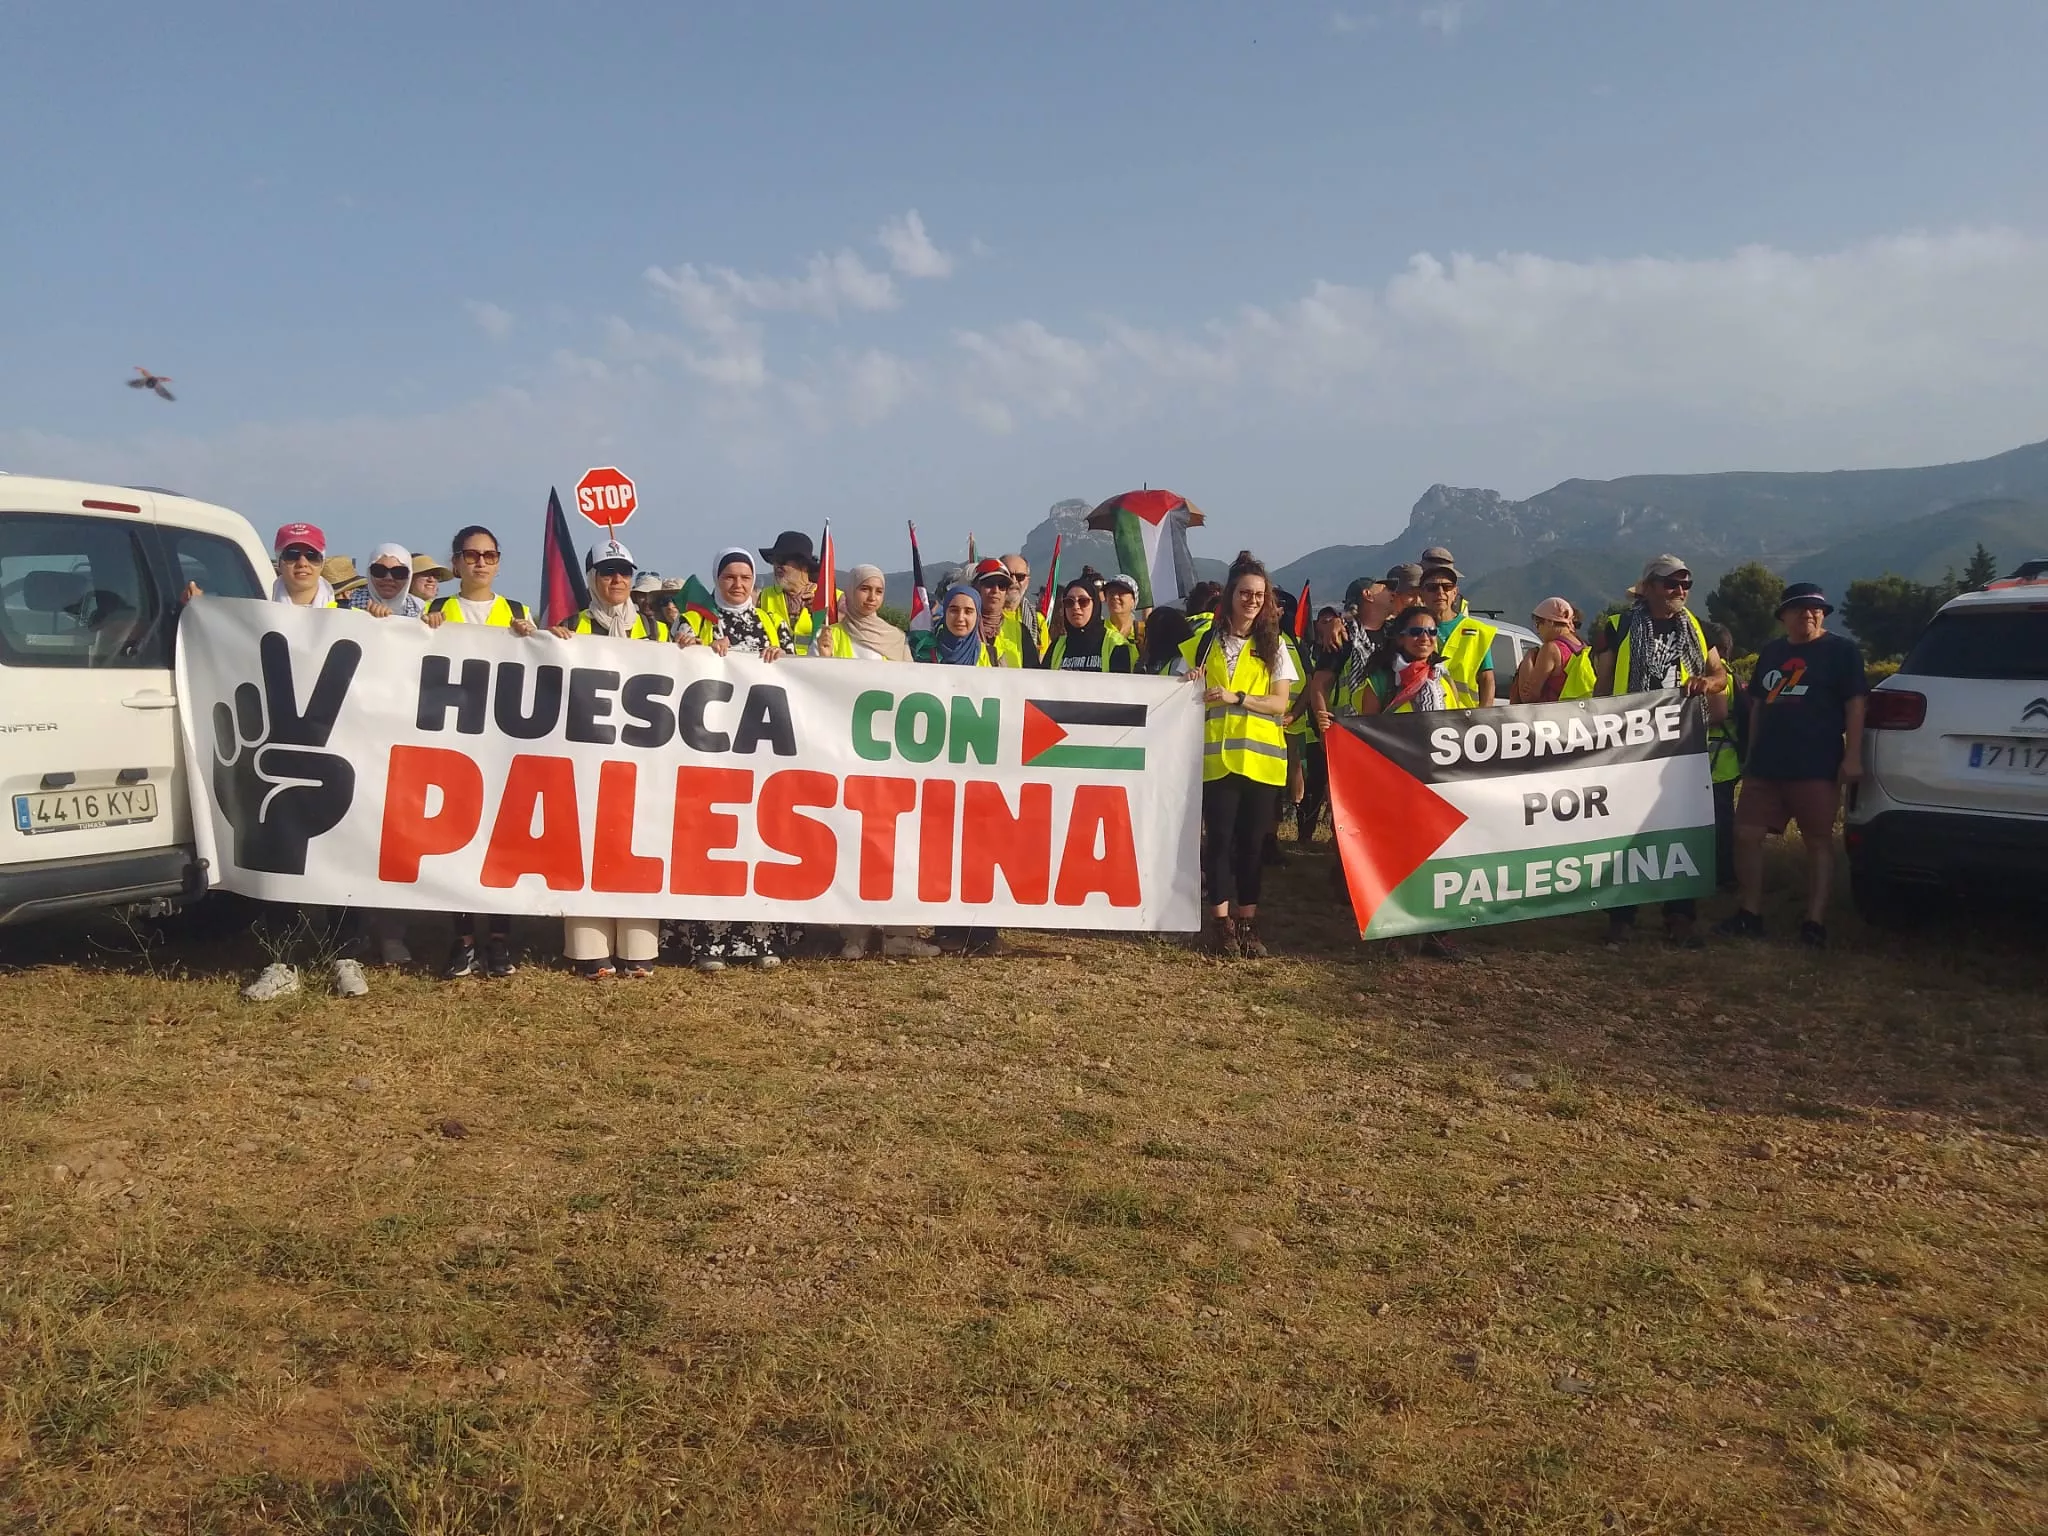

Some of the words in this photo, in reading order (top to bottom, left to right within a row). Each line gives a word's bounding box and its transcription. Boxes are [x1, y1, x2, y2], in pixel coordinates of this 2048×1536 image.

[580, 484, 633, 512] STOP
[416, 655, 797, 756] HUESCA
[851, 689, 1002, 765] CON
[1429, 704, 1682, 766] SOBRARBE
[37, 795, 99, 823] 4416
[107, 789, 150, 816] KYJ
[379, 745, 1142, 907] PALESTINA
[1522, 785, 1610, 826] POR
[1433, 842, 1700, 909] PALESTINA
